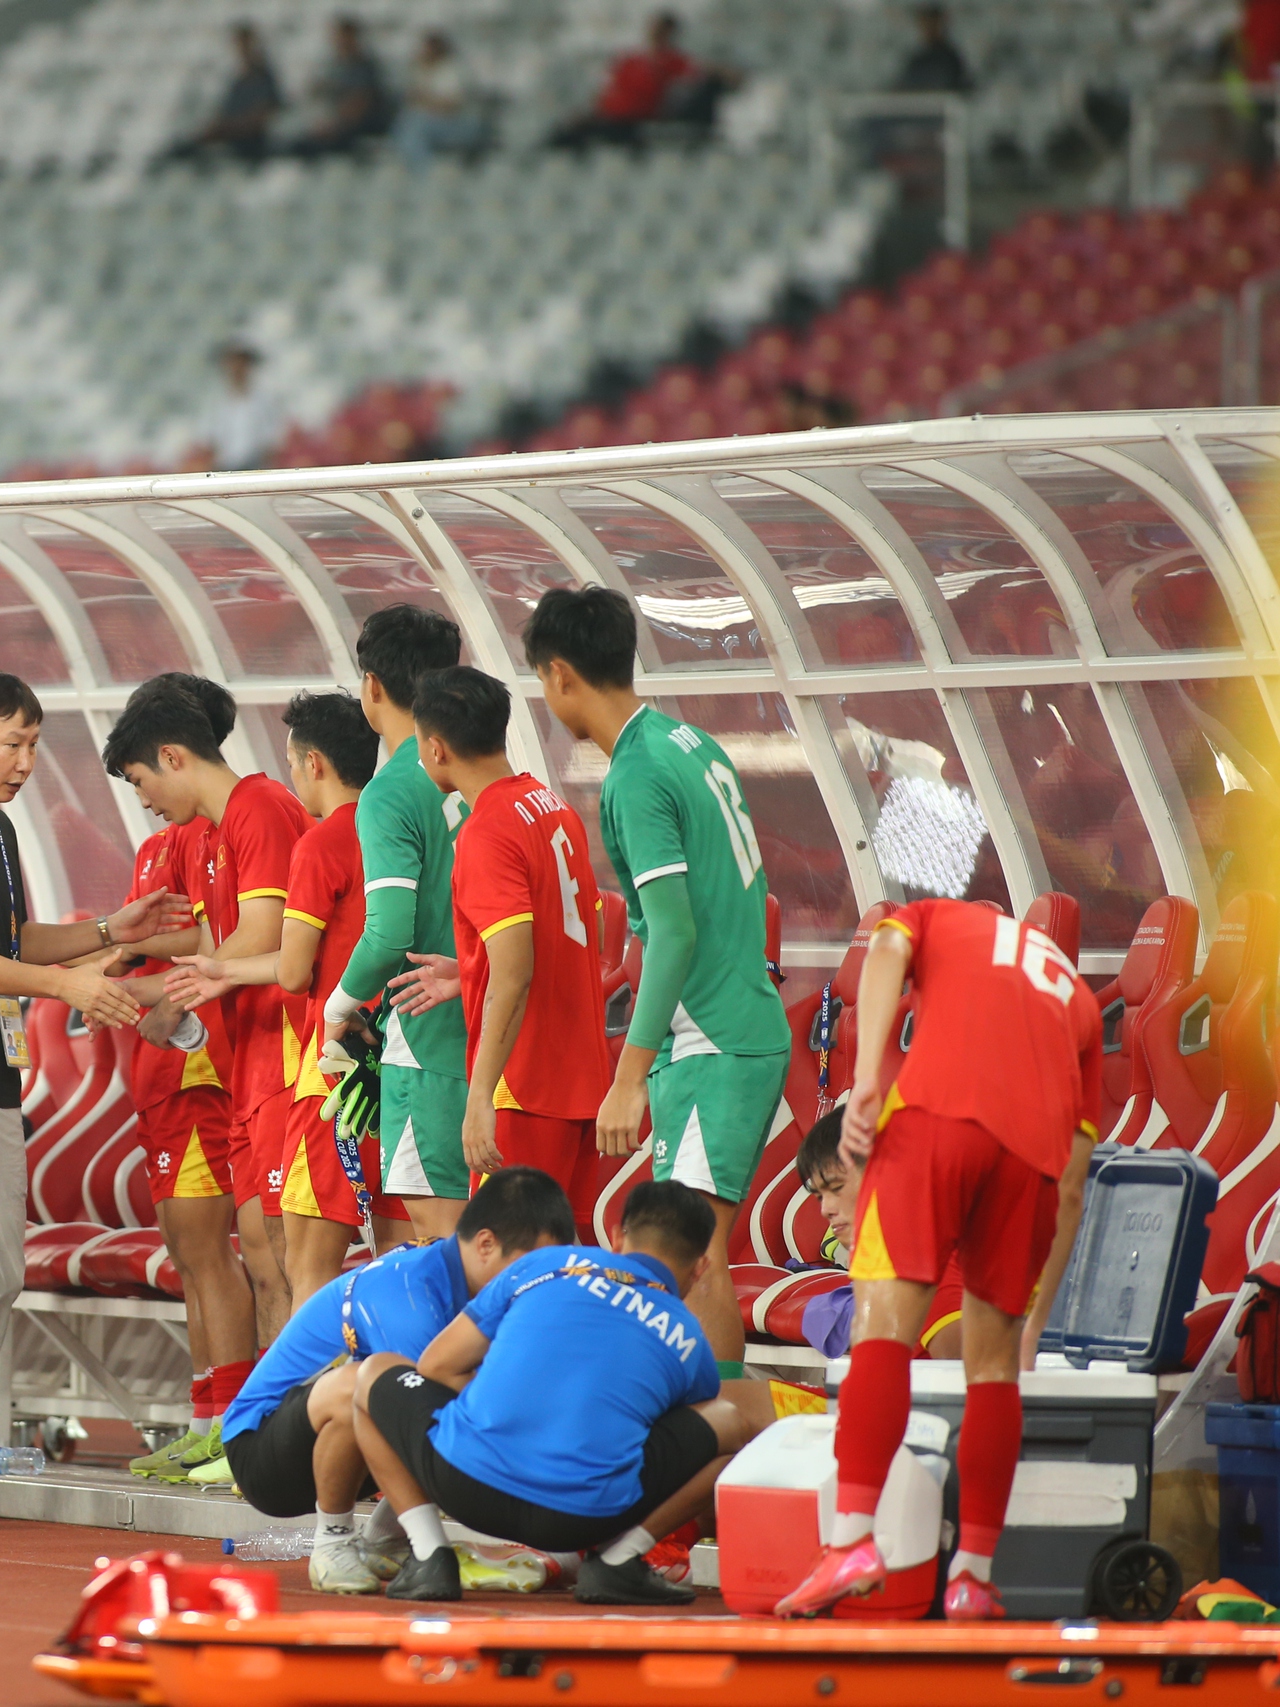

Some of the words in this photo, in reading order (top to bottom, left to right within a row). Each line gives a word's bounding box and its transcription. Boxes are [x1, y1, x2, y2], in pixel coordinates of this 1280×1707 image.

[821, 1001, 829, 1022] 2025
[337, 1141, 348, 1155] CUP
[348, 1137, 358, 1156] 2025
[562, 1253, 697, 1363] VIETNAM
